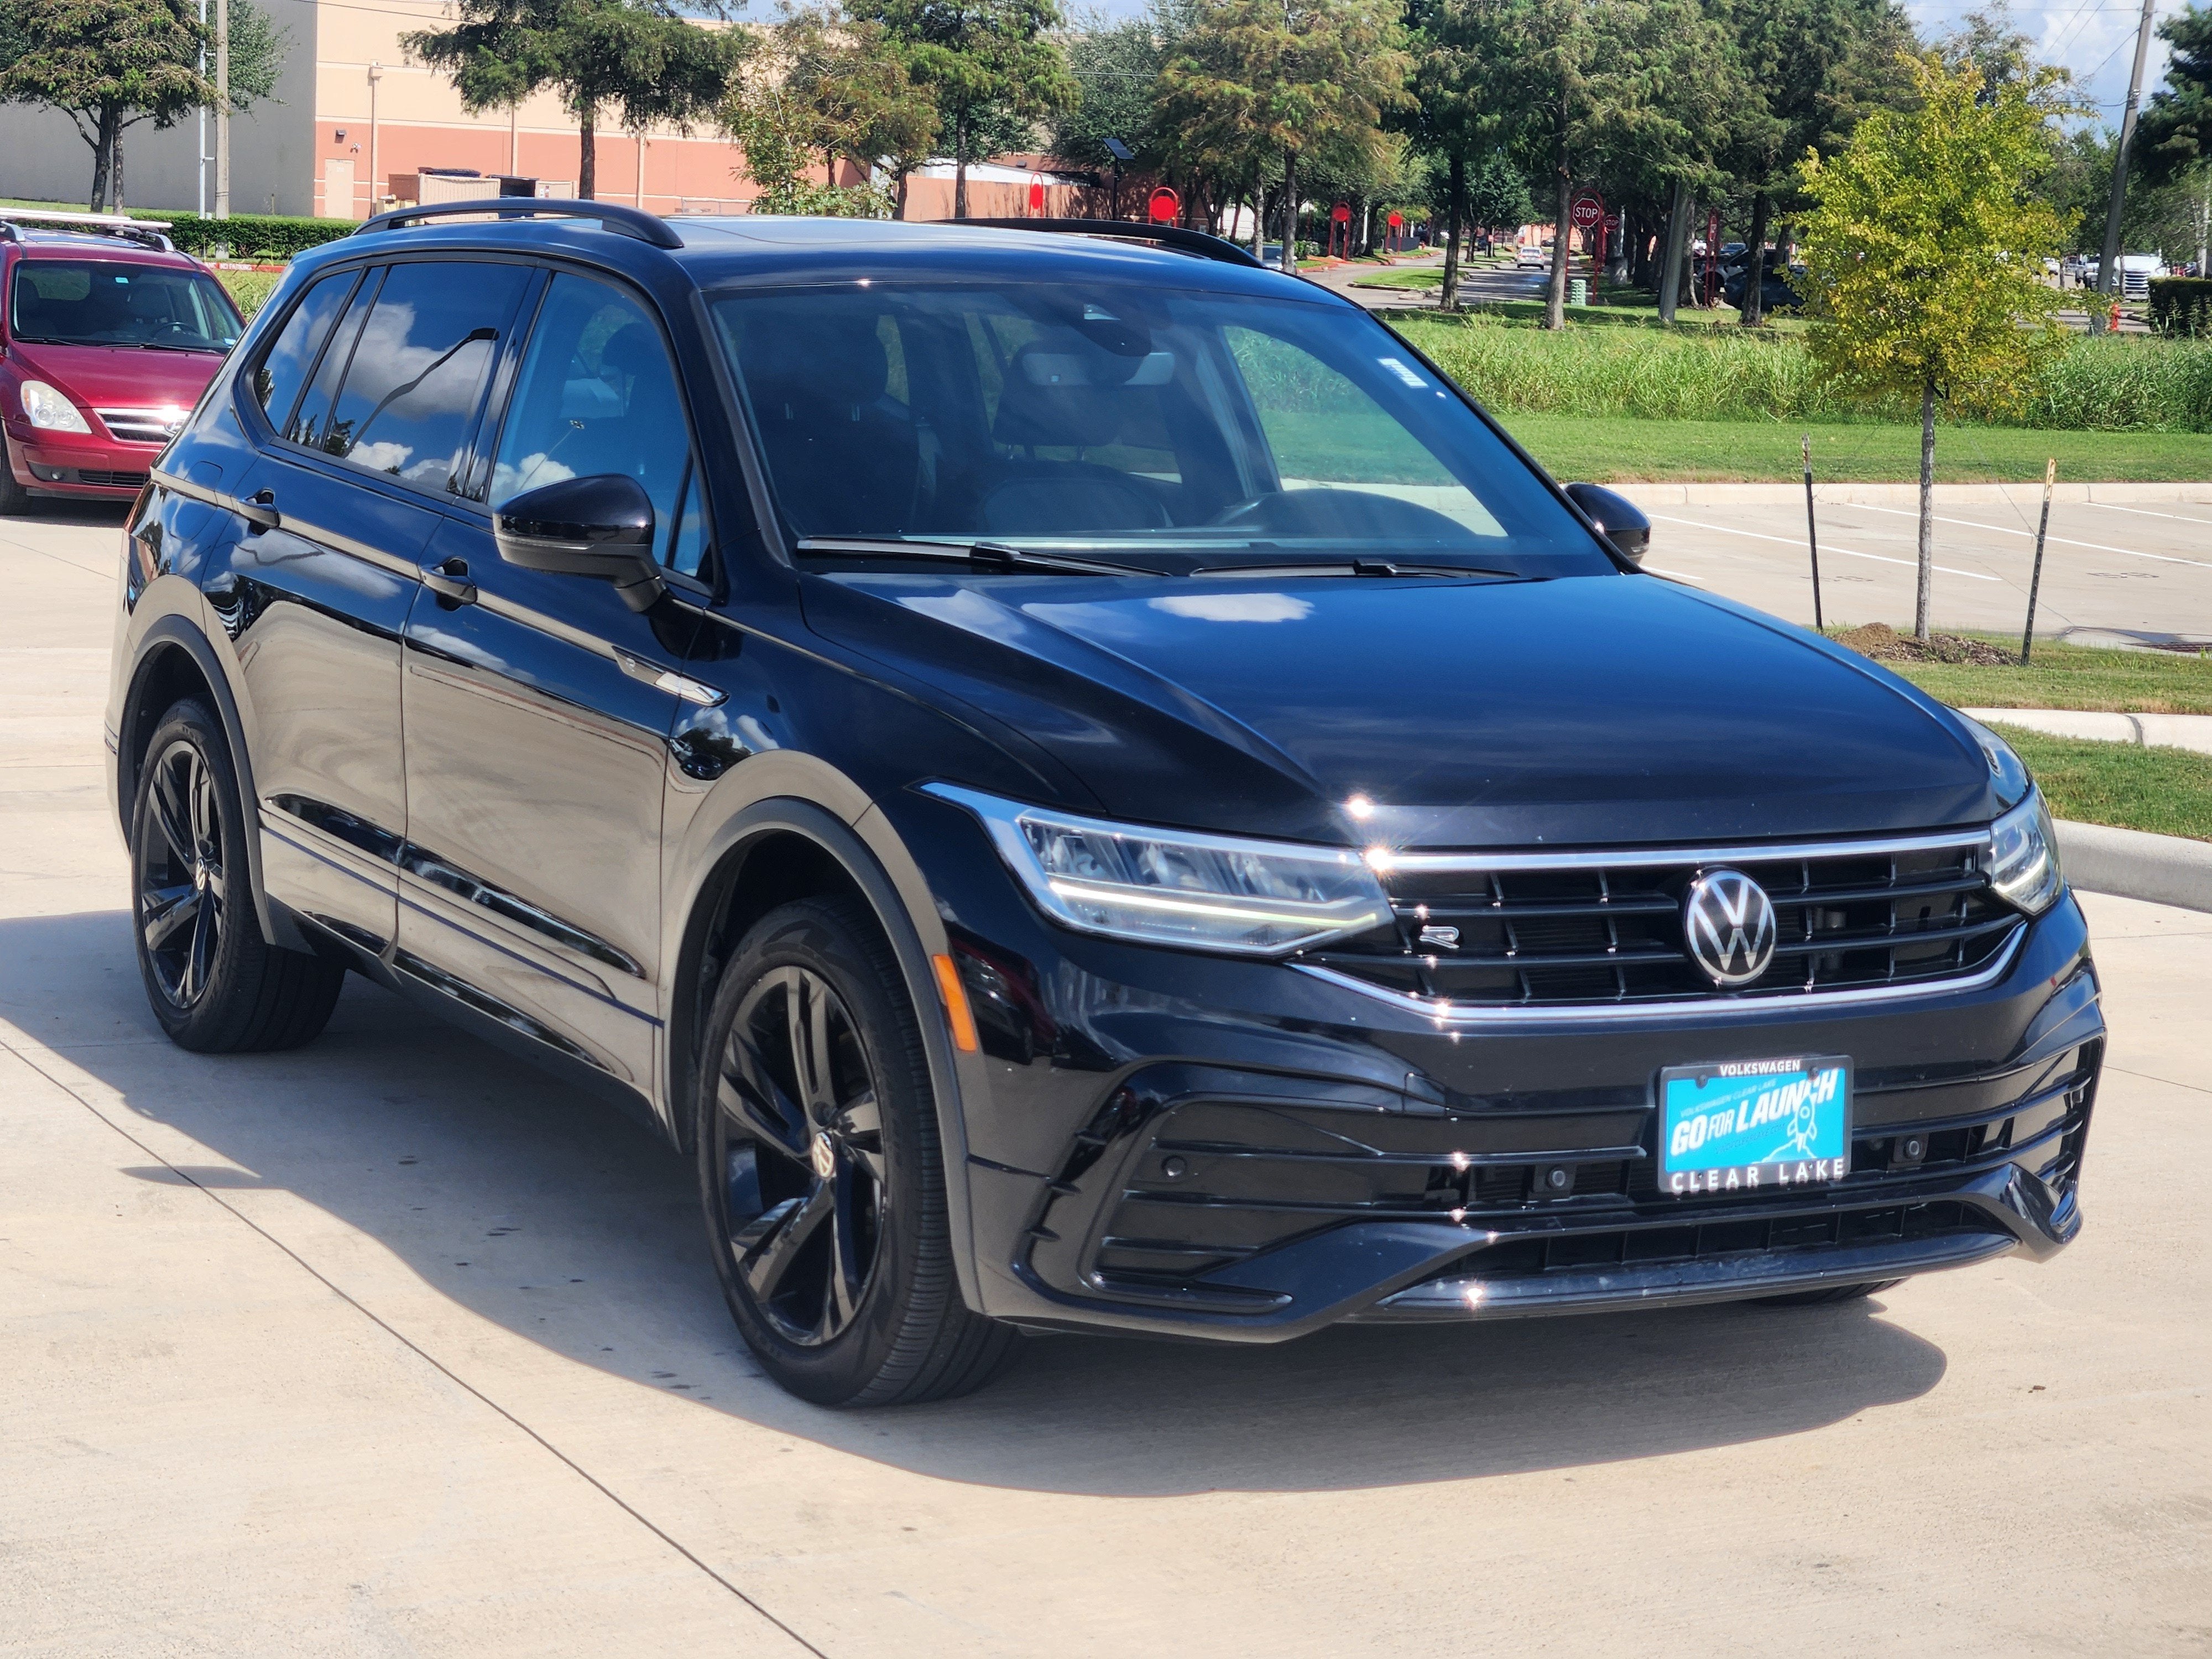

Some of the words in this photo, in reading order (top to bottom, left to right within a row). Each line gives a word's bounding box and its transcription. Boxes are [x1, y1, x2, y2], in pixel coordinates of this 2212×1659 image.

[1575, 207, 1598, 218] STOP
[1719, 1060, 1801, 1076] VOLKSWAGEN
[1671, 1114, 1708, 1156] GO
[1707, 1109, 1735, 1141] FOR
[1736, 1068, 1839, 1133] LAUNCH
[1671, 1166, 1759, 1191] CLEAR
[1779, 1159, 1844, 1181] LAKE
